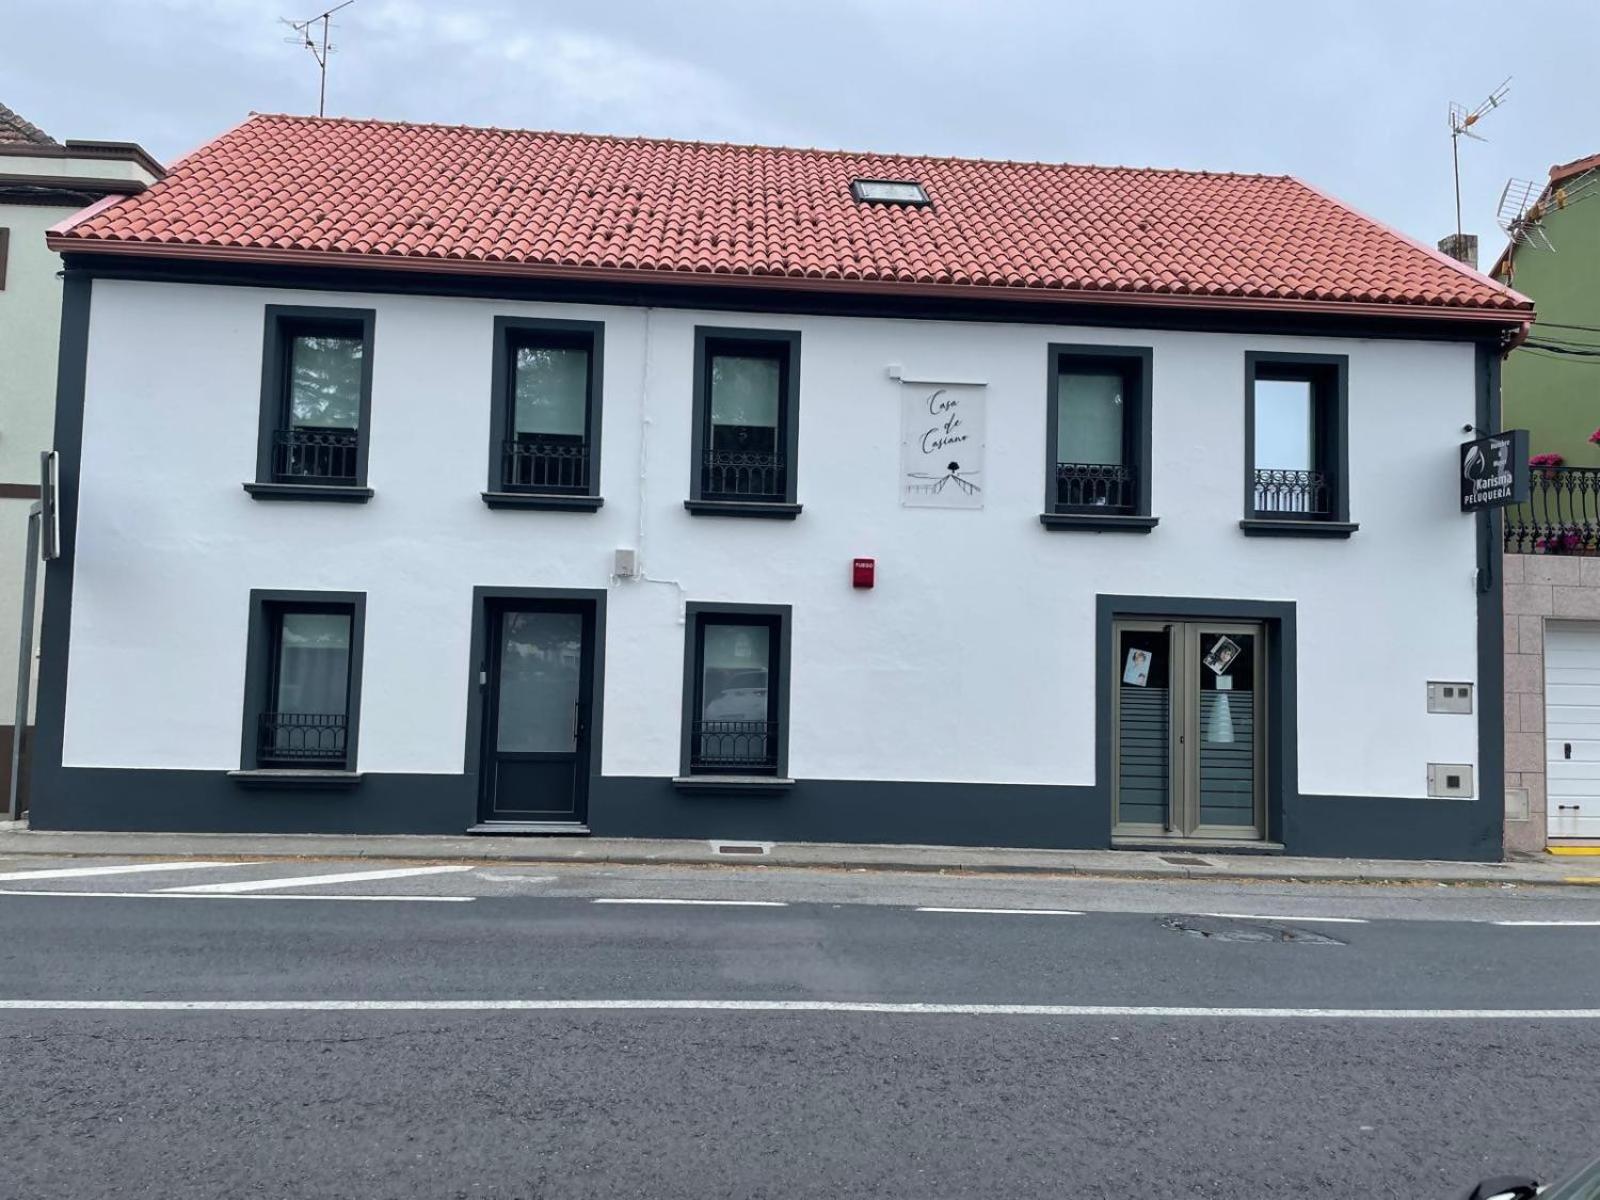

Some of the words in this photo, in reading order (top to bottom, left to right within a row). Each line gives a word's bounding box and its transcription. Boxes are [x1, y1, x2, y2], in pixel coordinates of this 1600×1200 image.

[926, 389, 960, 416] Casa
[943, 413, 961, 434] de
[920, 428, 968, 454] Casiano
[1476, 473, 1512, 490] Karisma
[1464, 486, 1511, 504] PELUQUERÍA
